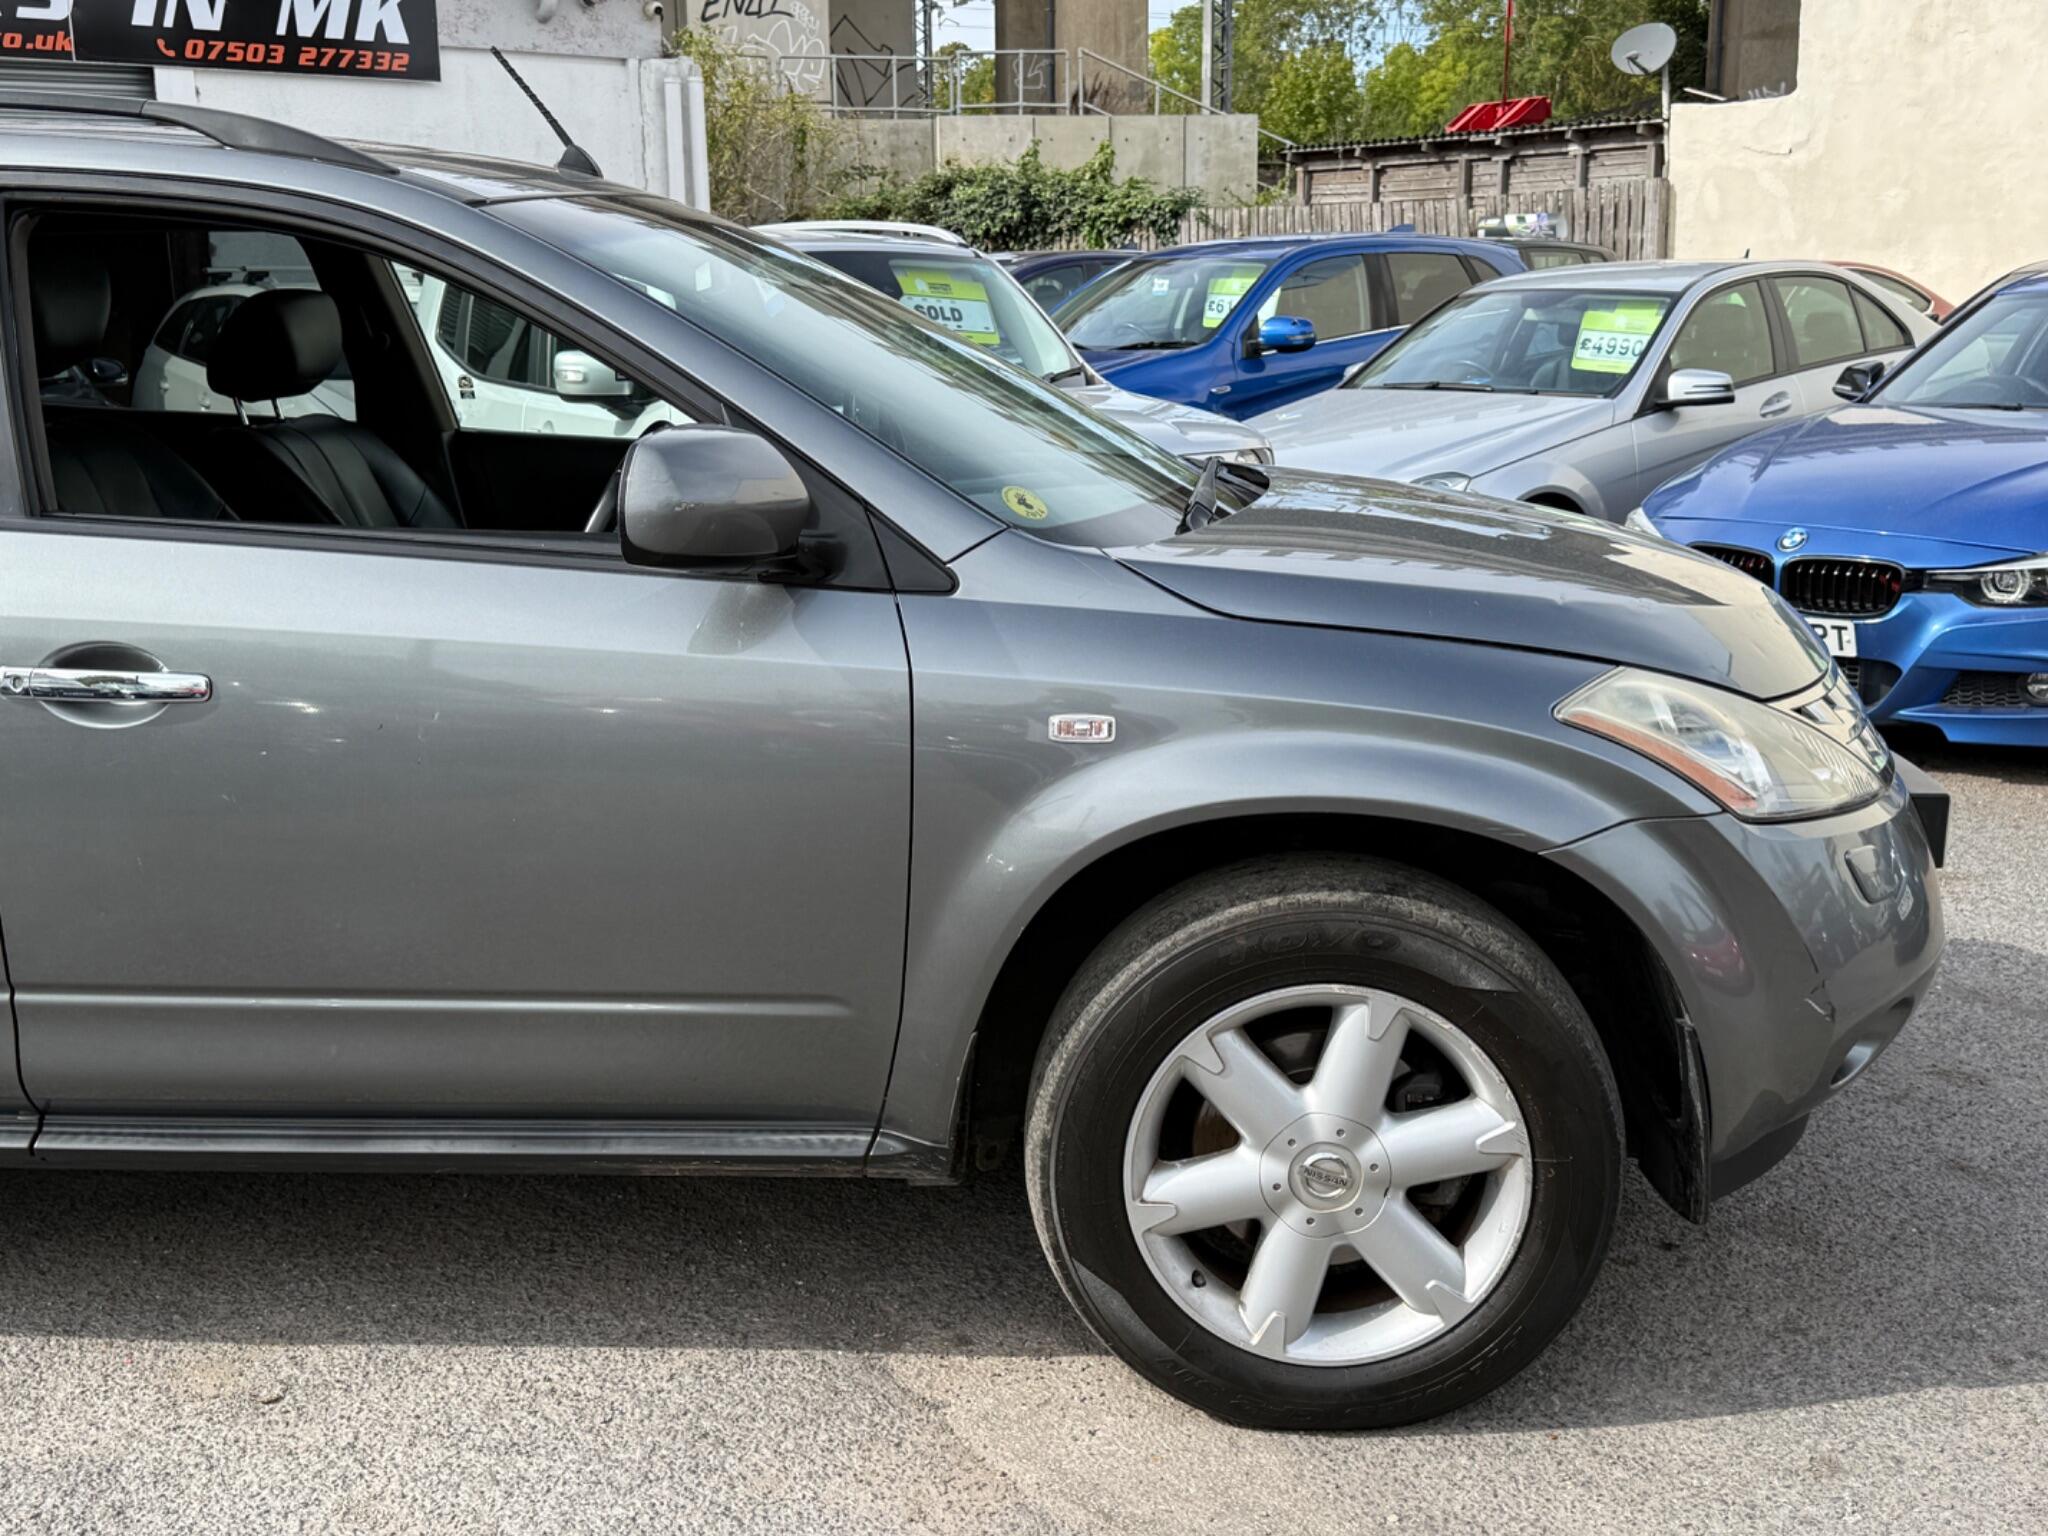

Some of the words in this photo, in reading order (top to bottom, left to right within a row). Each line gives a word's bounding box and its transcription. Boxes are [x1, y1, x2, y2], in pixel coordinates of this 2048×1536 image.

[184, 39, 285, 64] 07503
[298, 46, 410, 72] 277332
[914, 304, 963, 322] SOLD
[1580, 337, 1643, 357] £4990
[1303, 1167, 1347, 1186] NISSAN
